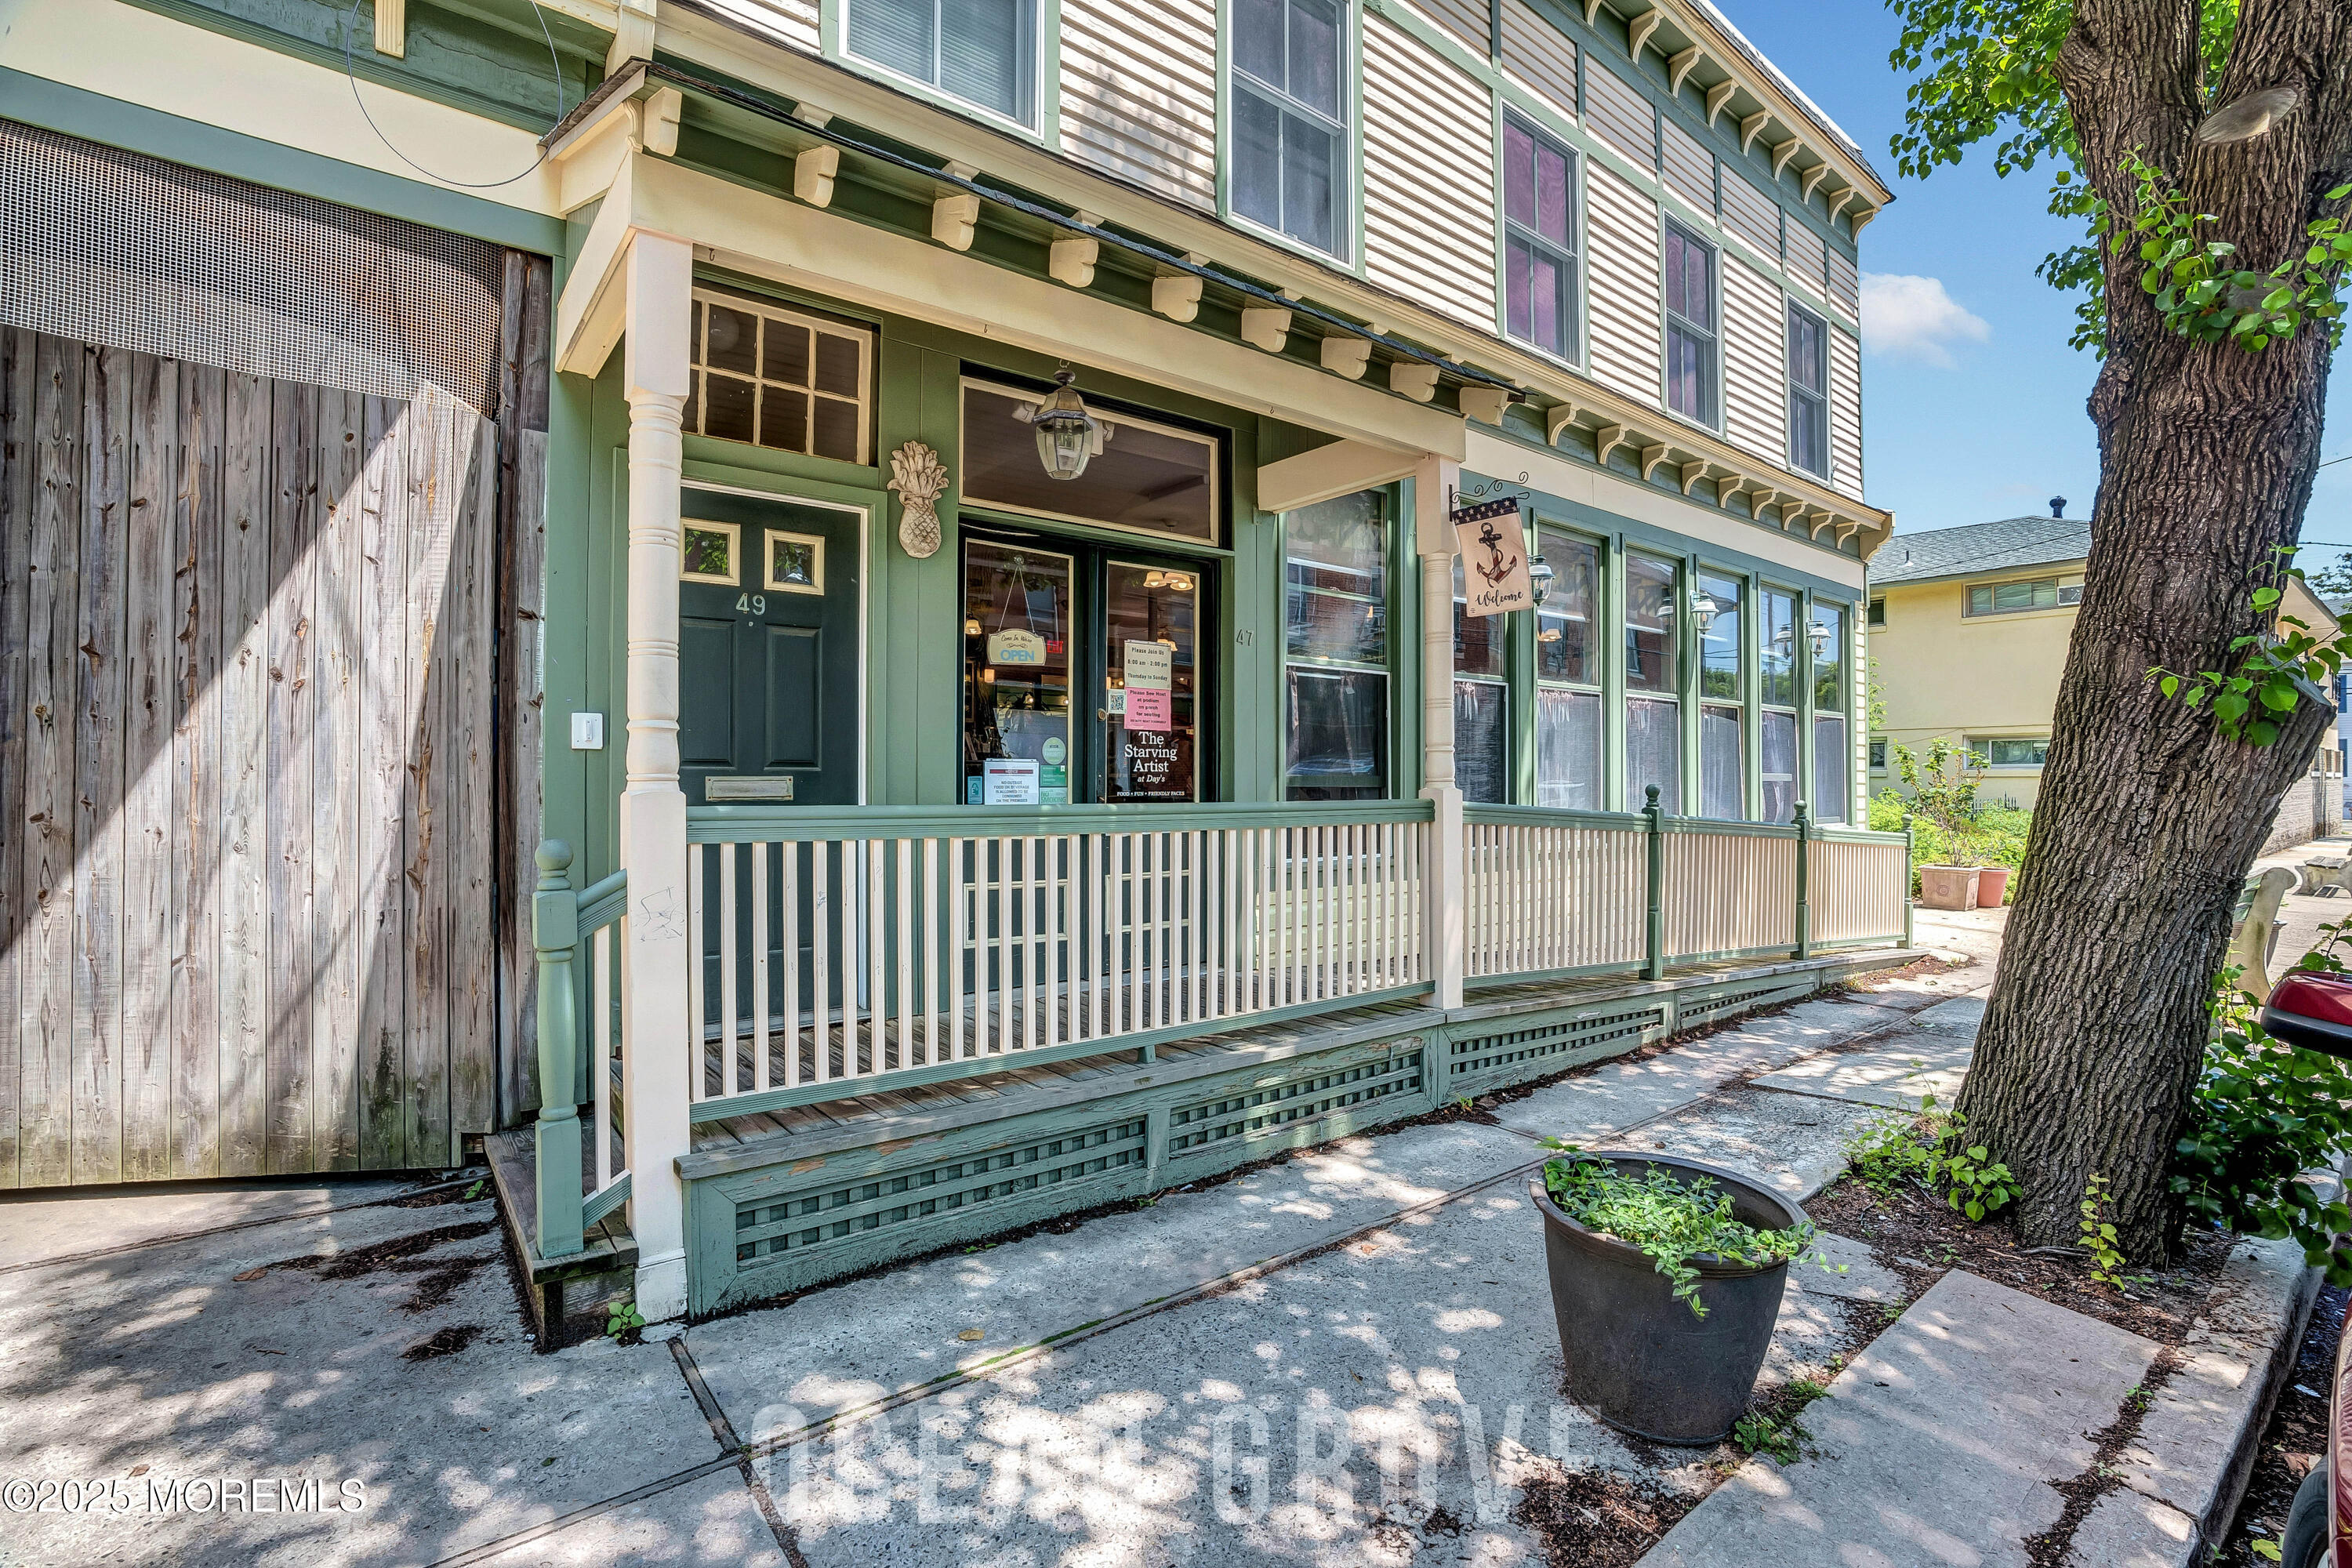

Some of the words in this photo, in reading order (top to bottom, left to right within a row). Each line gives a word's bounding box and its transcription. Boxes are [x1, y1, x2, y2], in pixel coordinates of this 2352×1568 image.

[735, 593, 766, 615] 49
[1475, 589, 1523, 607] Welcome
[1236, 628, 1254, 647] 47
[1000, 649, 1035, 662] OPEN
[1138, 731, 1164, 745] The
[1124, 744, 1178, 761] Starving
[1133, 759, 1169, 772] Artist
[1146, 775, 1166, 784] Day's
